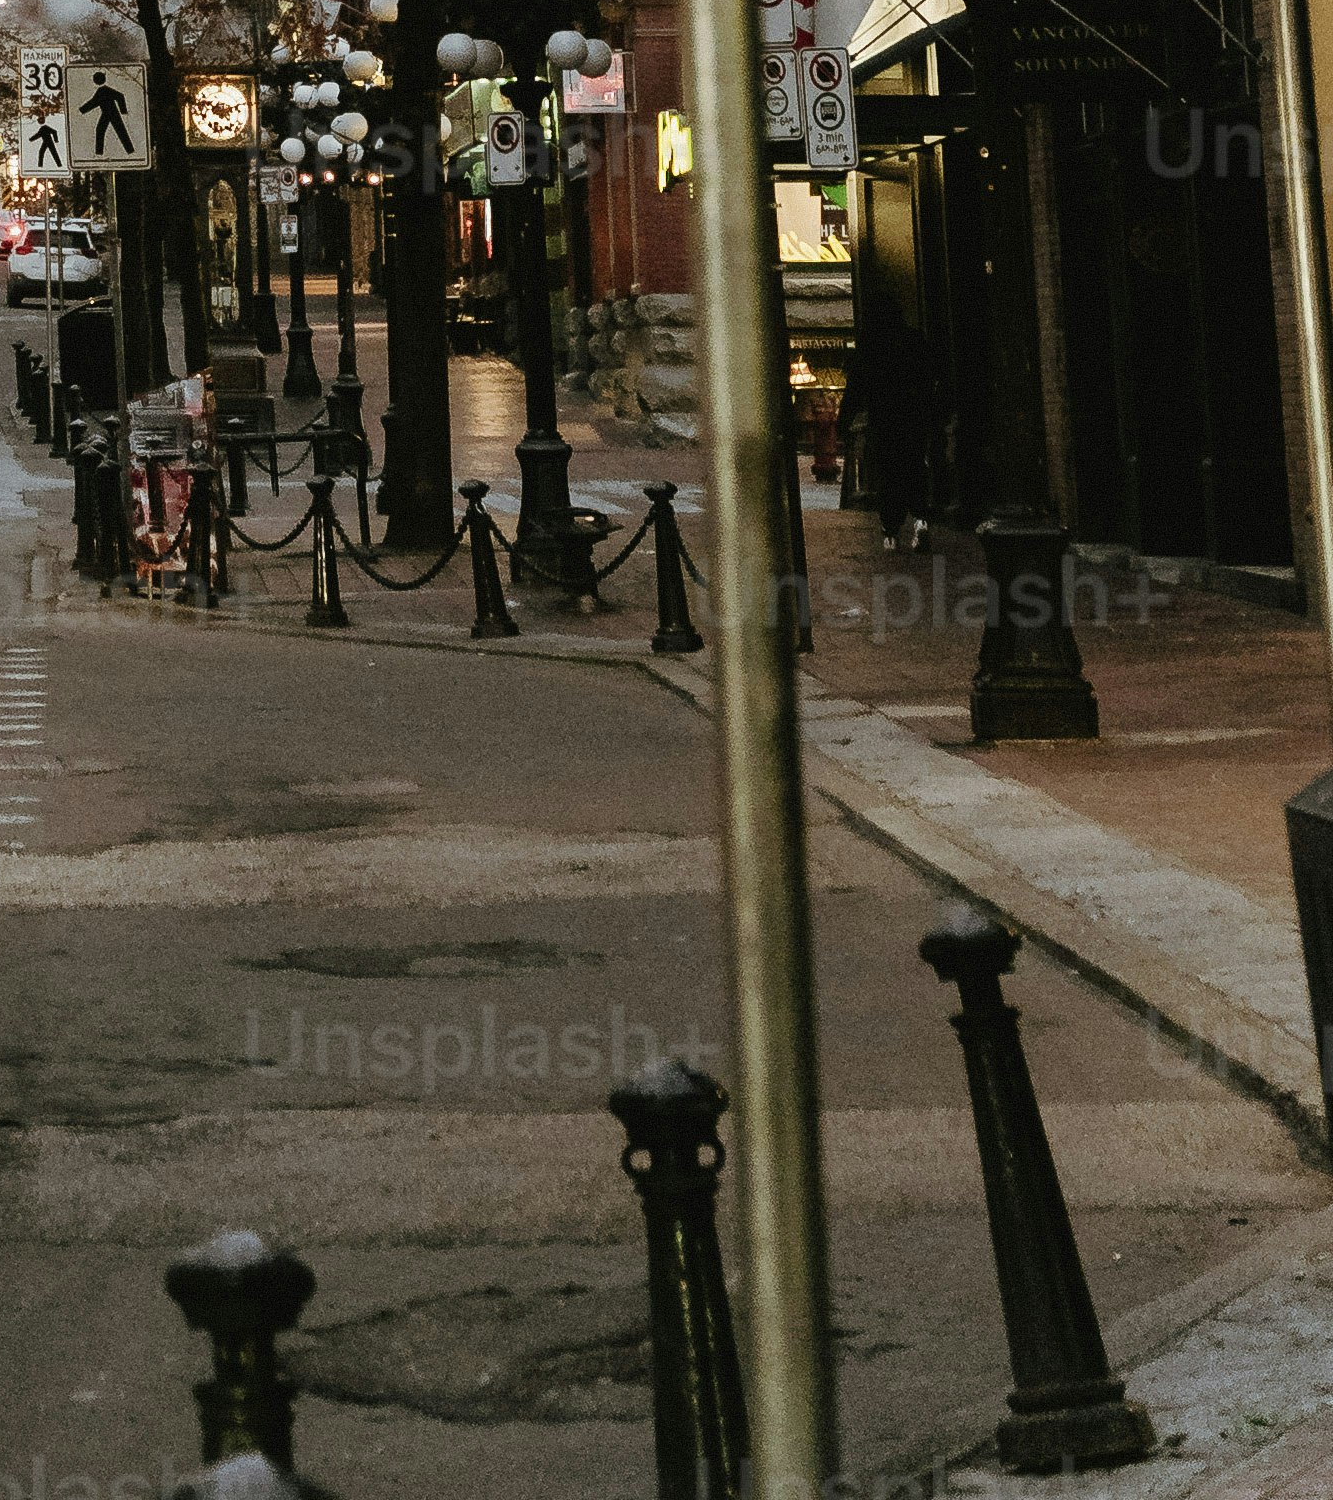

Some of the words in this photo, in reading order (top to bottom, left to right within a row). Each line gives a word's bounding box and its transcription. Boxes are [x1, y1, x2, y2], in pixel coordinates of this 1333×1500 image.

[23, 52, 64, 61] MAXIMUM
[24, 62, 64, 91] 30
[817, 132, 824, 143] 3
[825, 131, 845, 143] min
